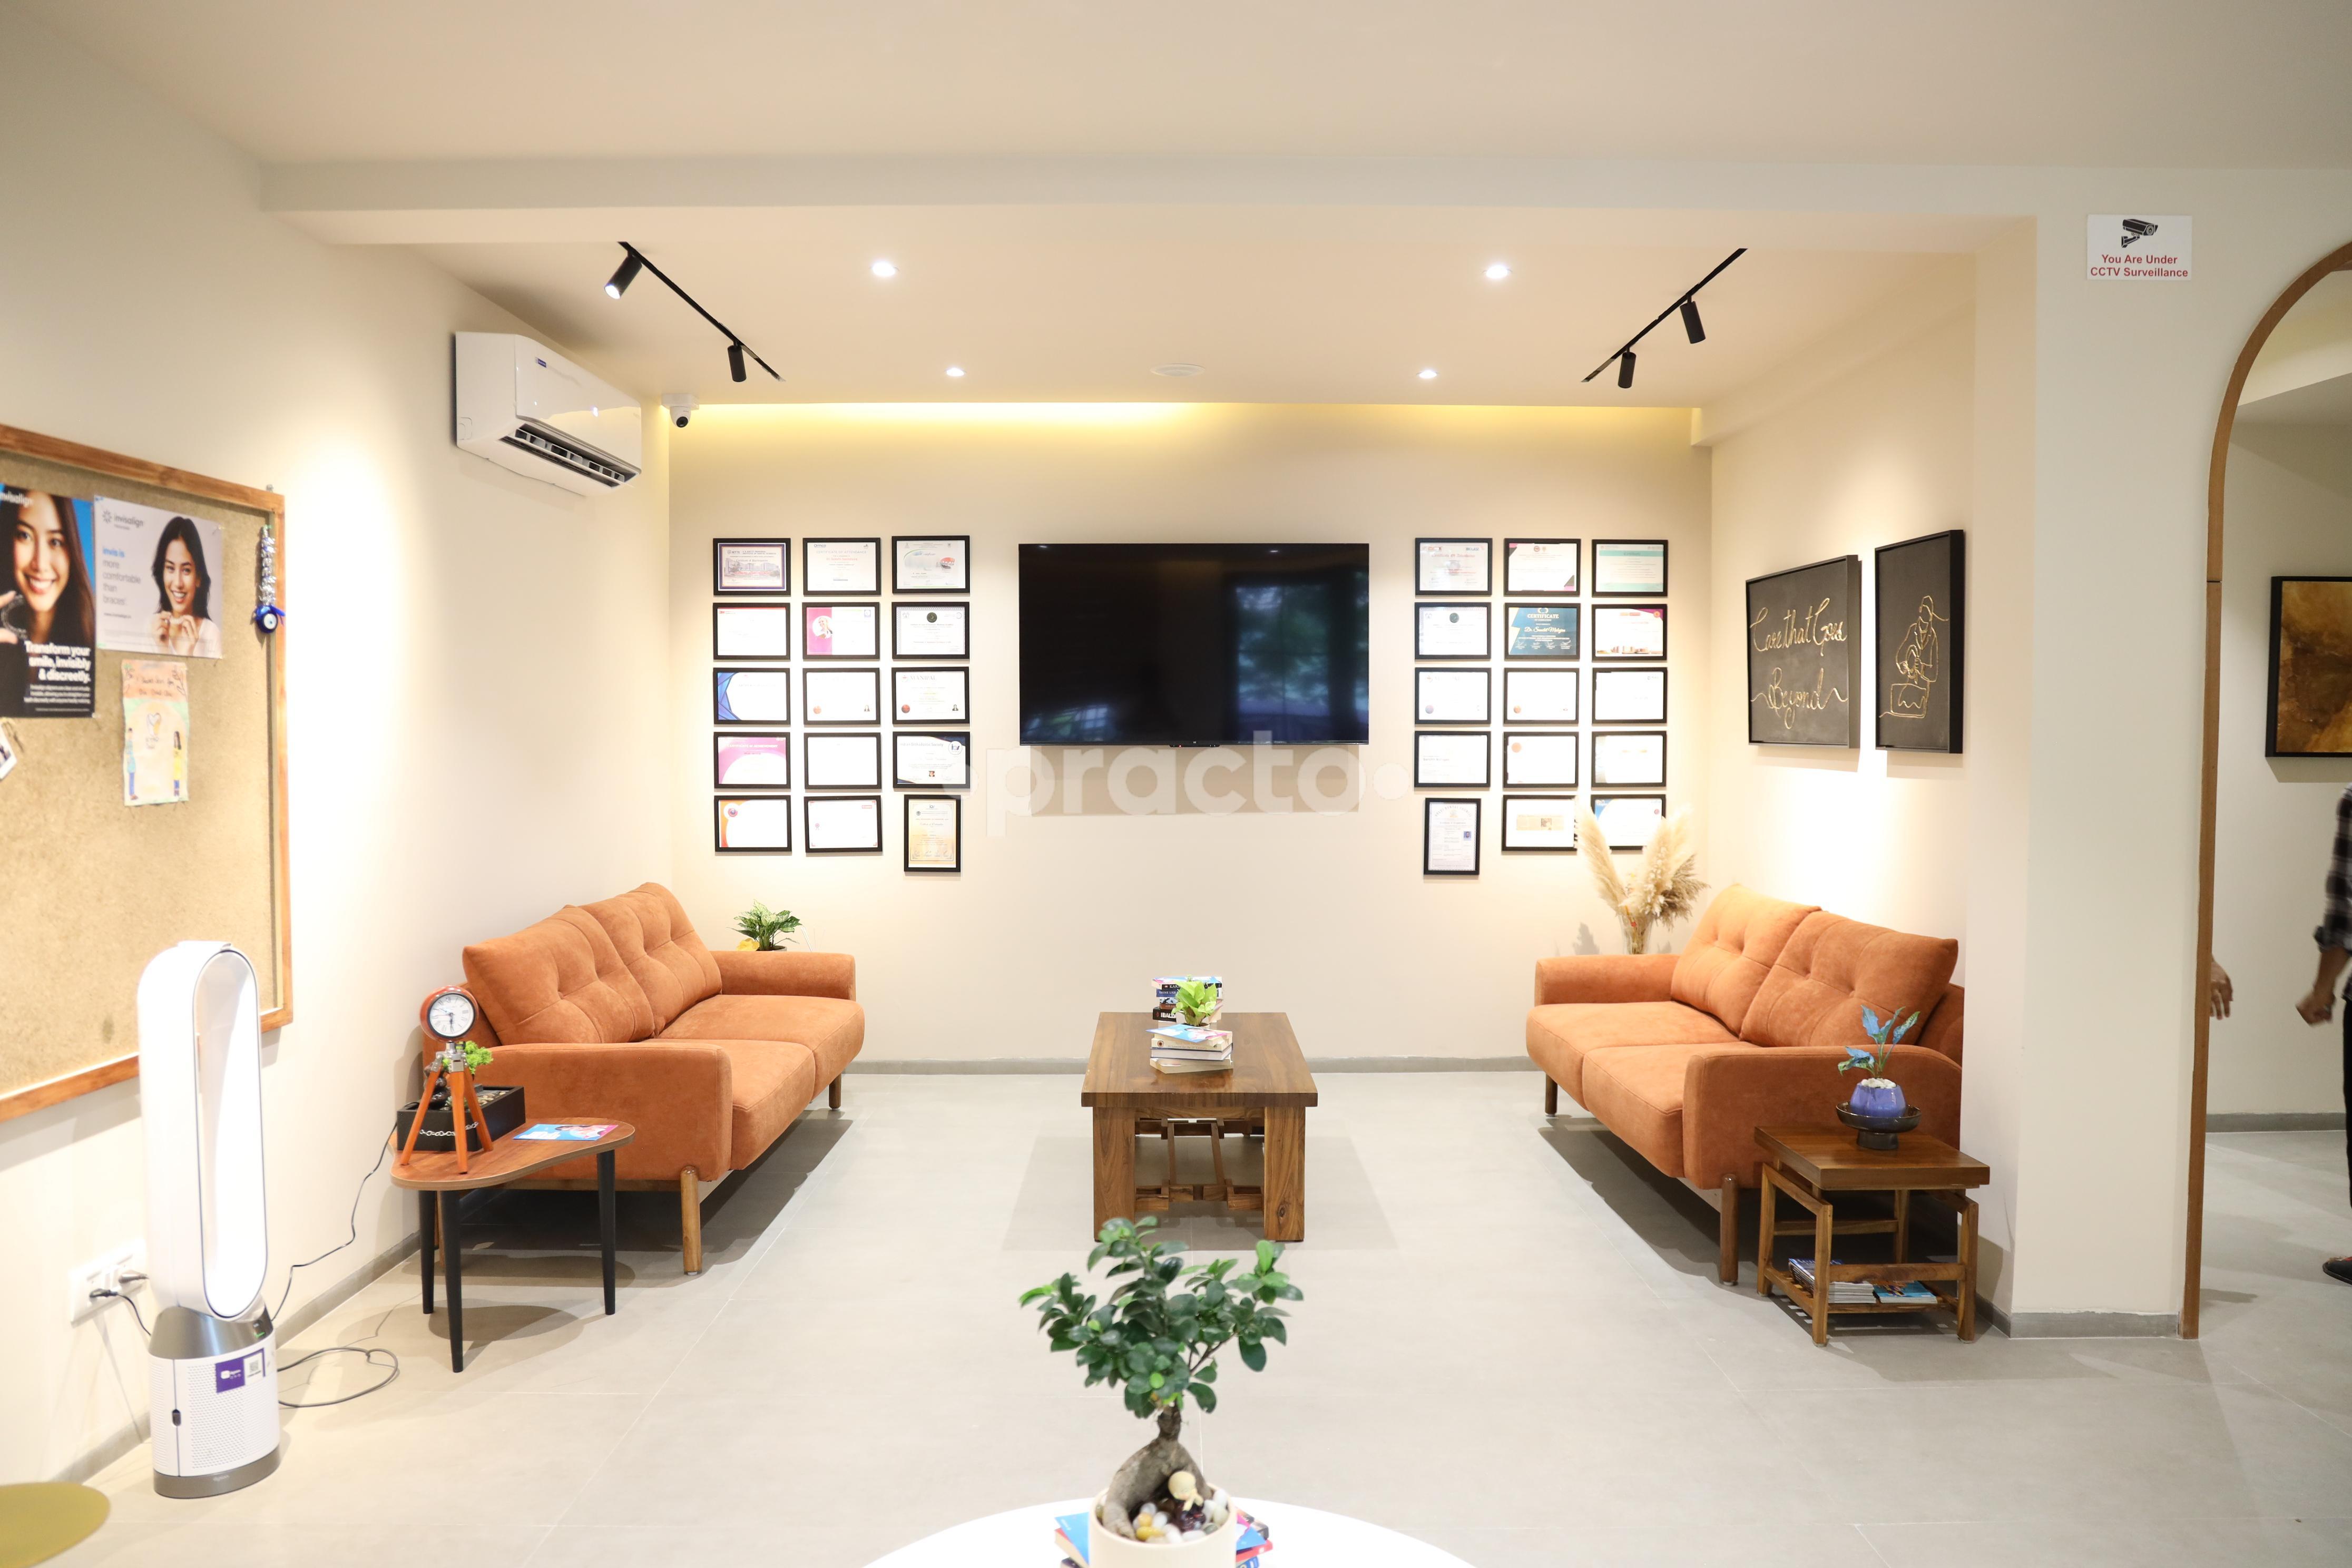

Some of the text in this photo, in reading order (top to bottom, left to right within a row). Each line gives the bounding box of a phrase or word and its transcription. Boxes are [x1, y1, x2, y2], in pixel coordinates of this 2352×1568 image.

[2102, 254, 2178, 264] You Are Under
[2091, 267, 2188, 277] CCTV Surveillance
[1783, 606, 1811, 648] that
[24, 640, 91, 658] Transform your
[28, 655, 91, 671] smile, invisibly
